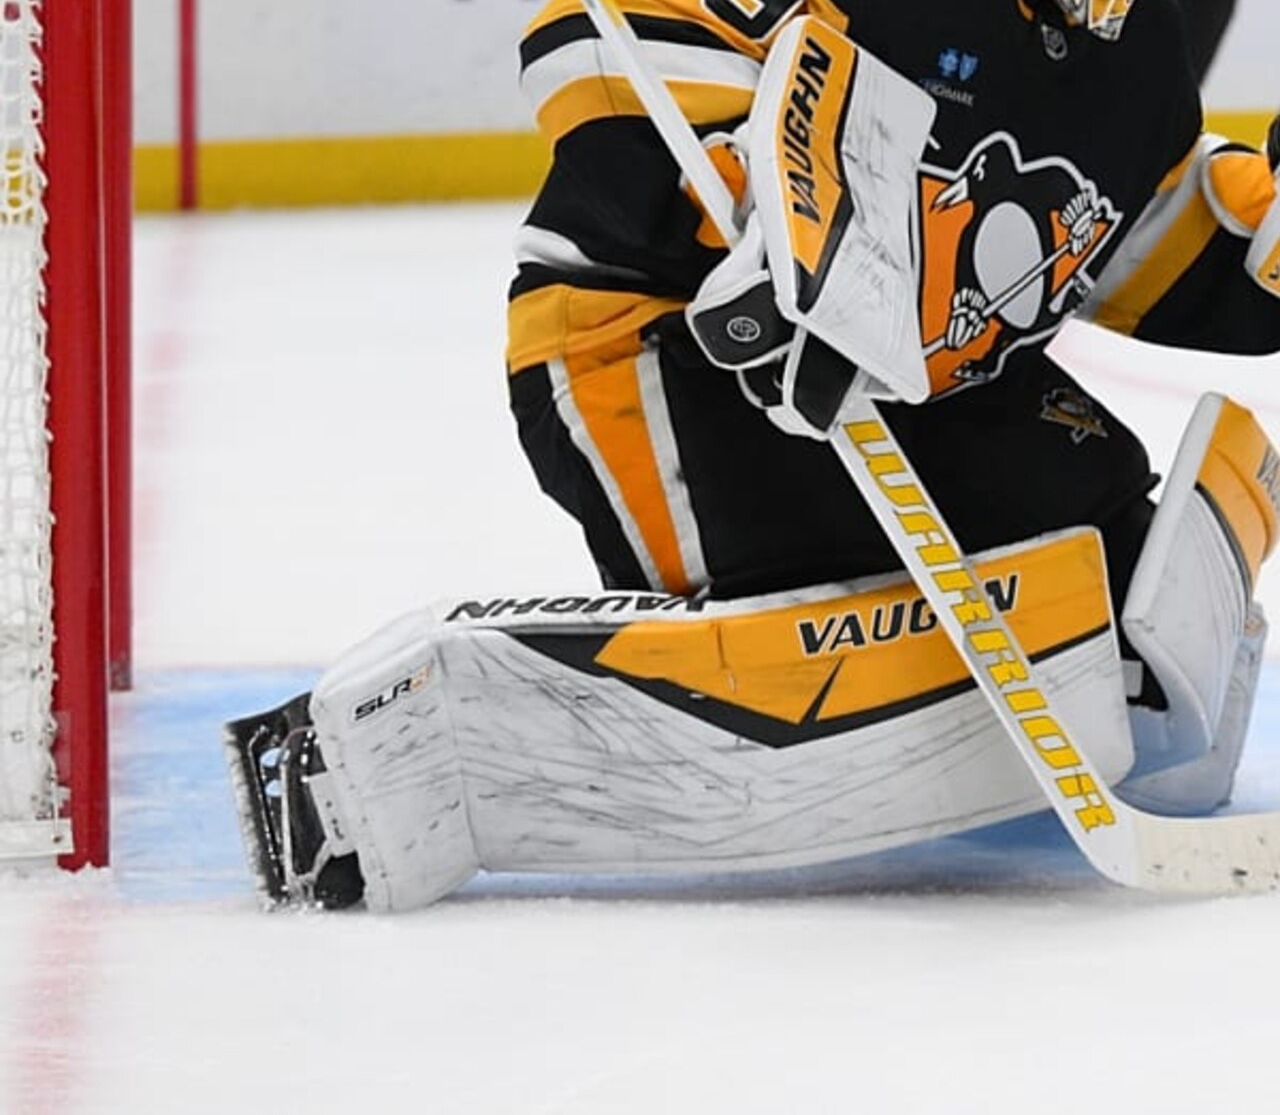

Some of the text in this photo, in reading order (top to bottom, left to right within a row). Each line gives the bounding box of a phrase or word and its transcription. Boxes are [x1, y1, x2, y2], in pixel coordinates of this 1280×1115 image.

[783, 37, 833, 226] VAUGHN
[798, 574, 1019, 655] VAUGN
[842, 419, 1117, 835] WARRIOR
